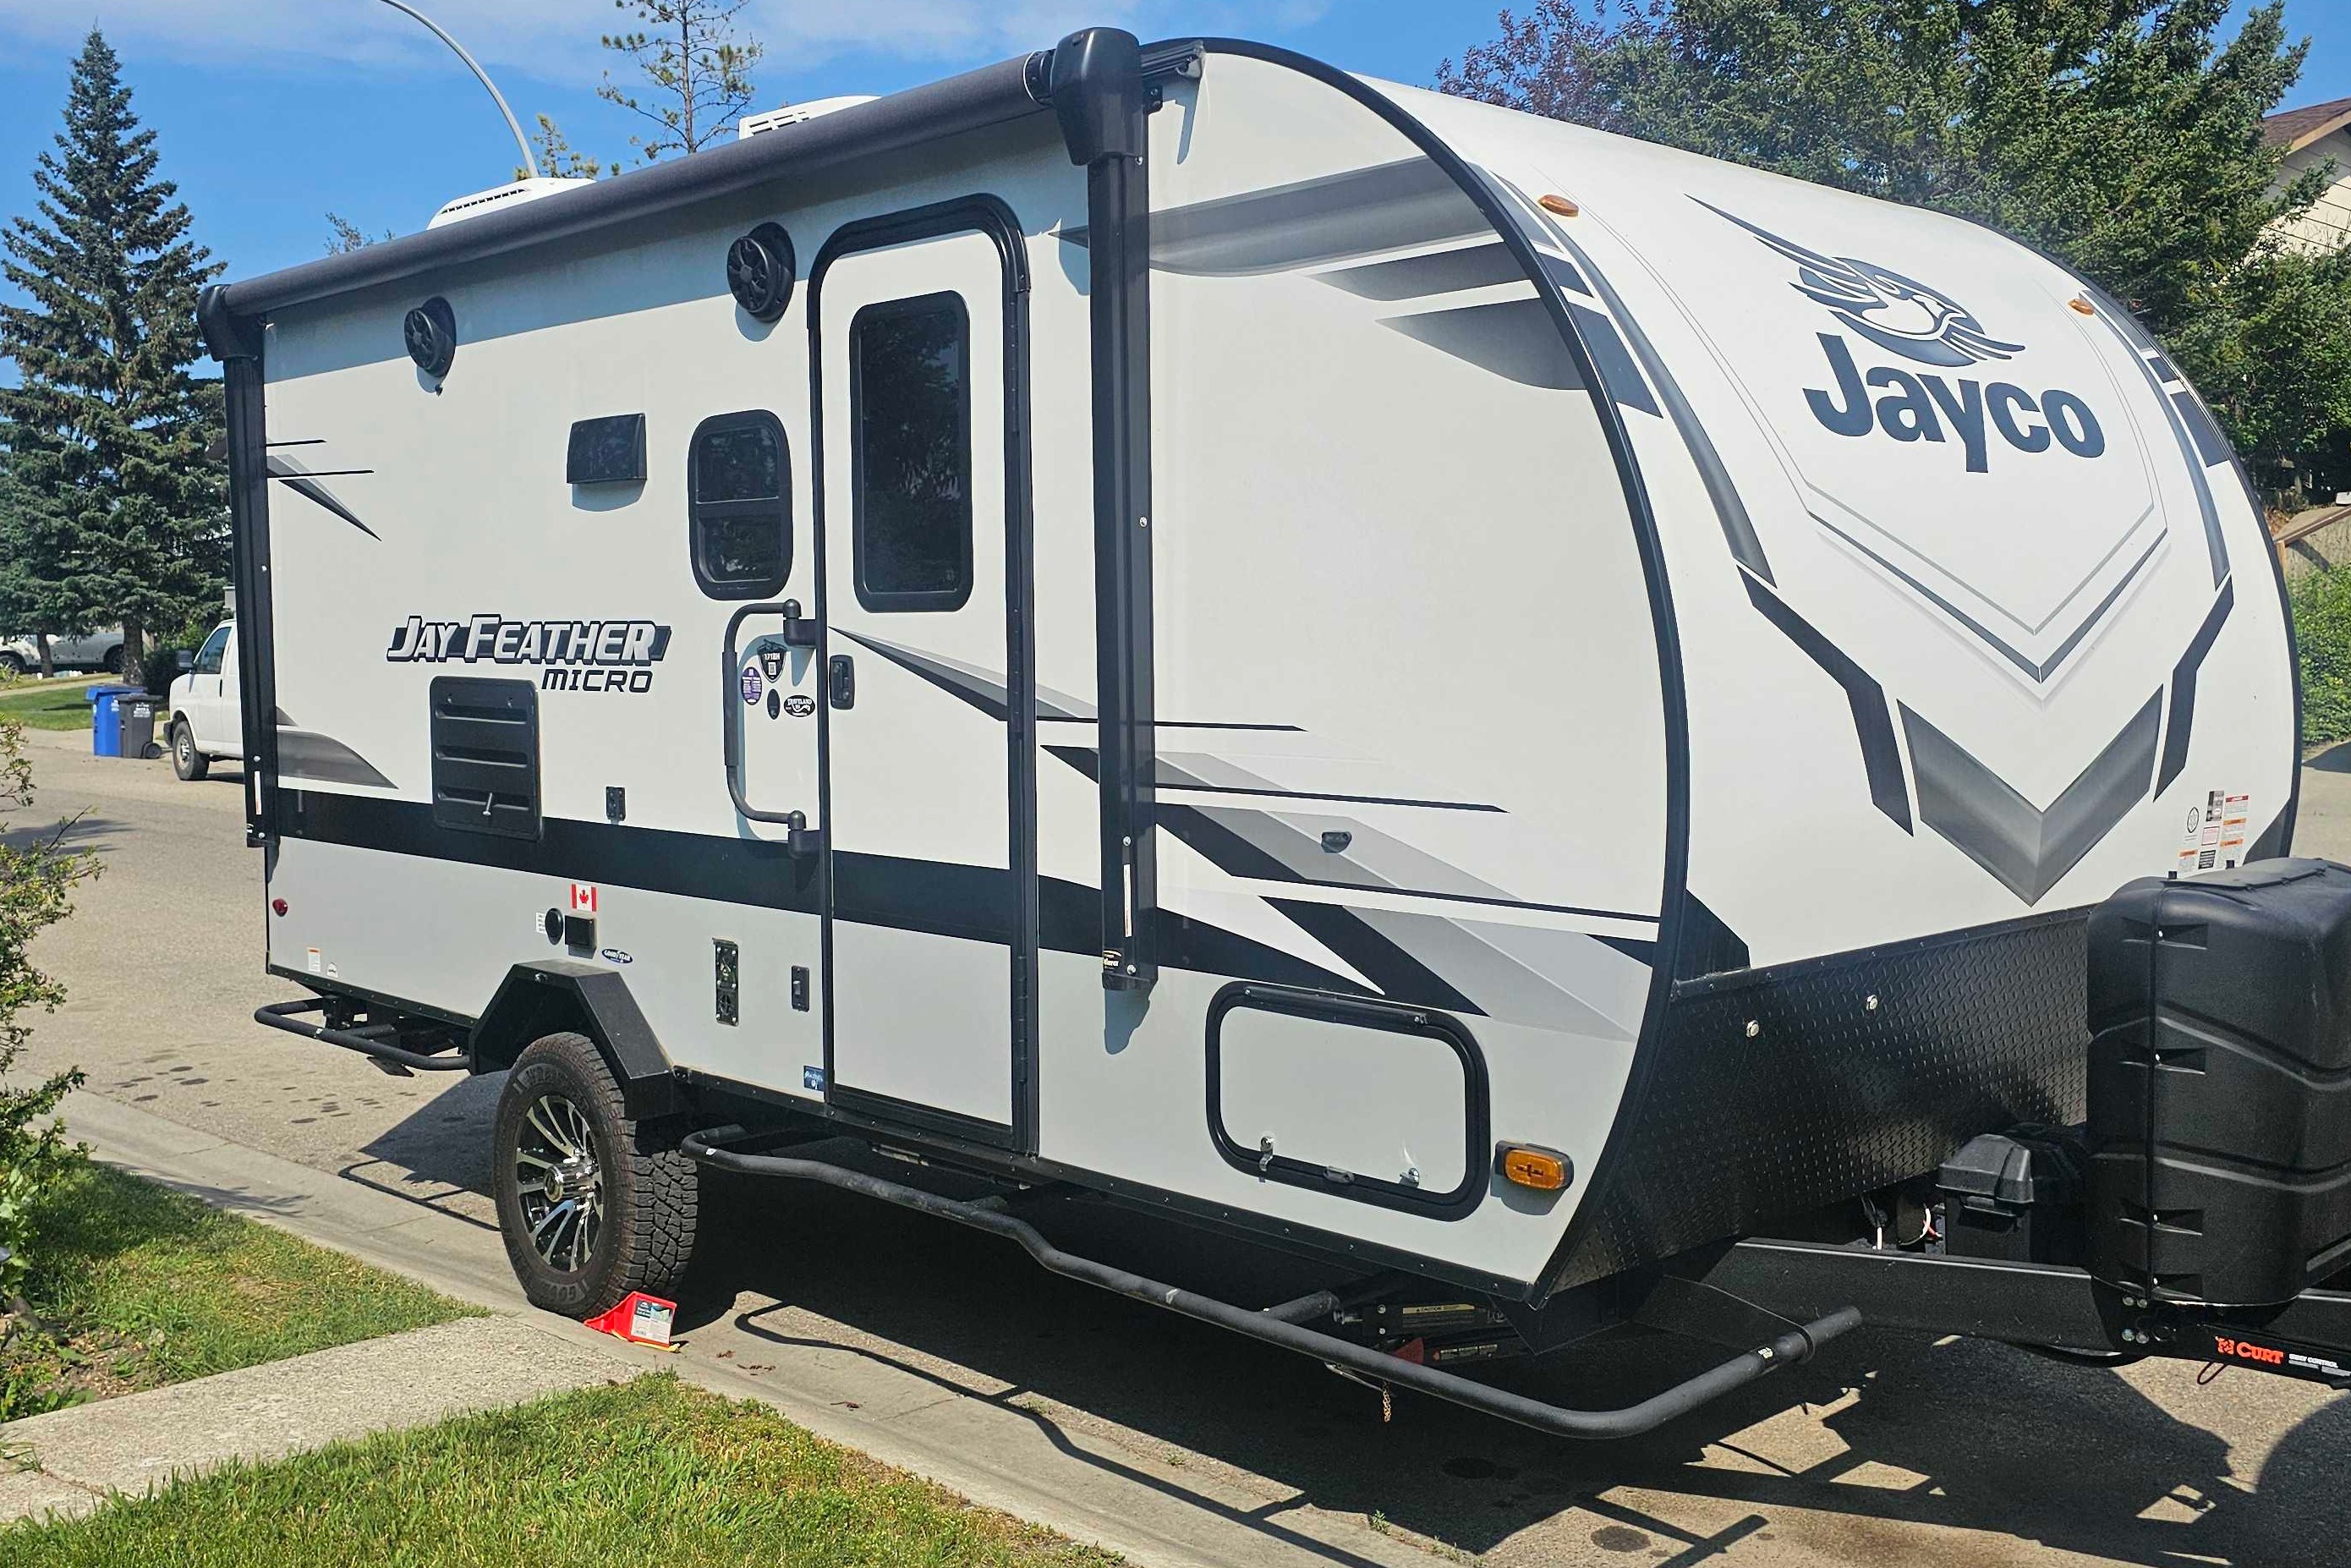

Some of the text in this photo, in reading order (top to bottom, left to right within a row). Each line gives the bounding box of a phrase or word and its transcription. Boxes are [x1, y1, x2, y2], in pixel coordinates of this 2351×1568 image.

[1802, 332, 2105, 473] Jayco
[386, 614, 656, 666] JAY FEATHER
[540, 668, 654, 694] MICRO
[2236, 1341, 2284, 1364] CURT
